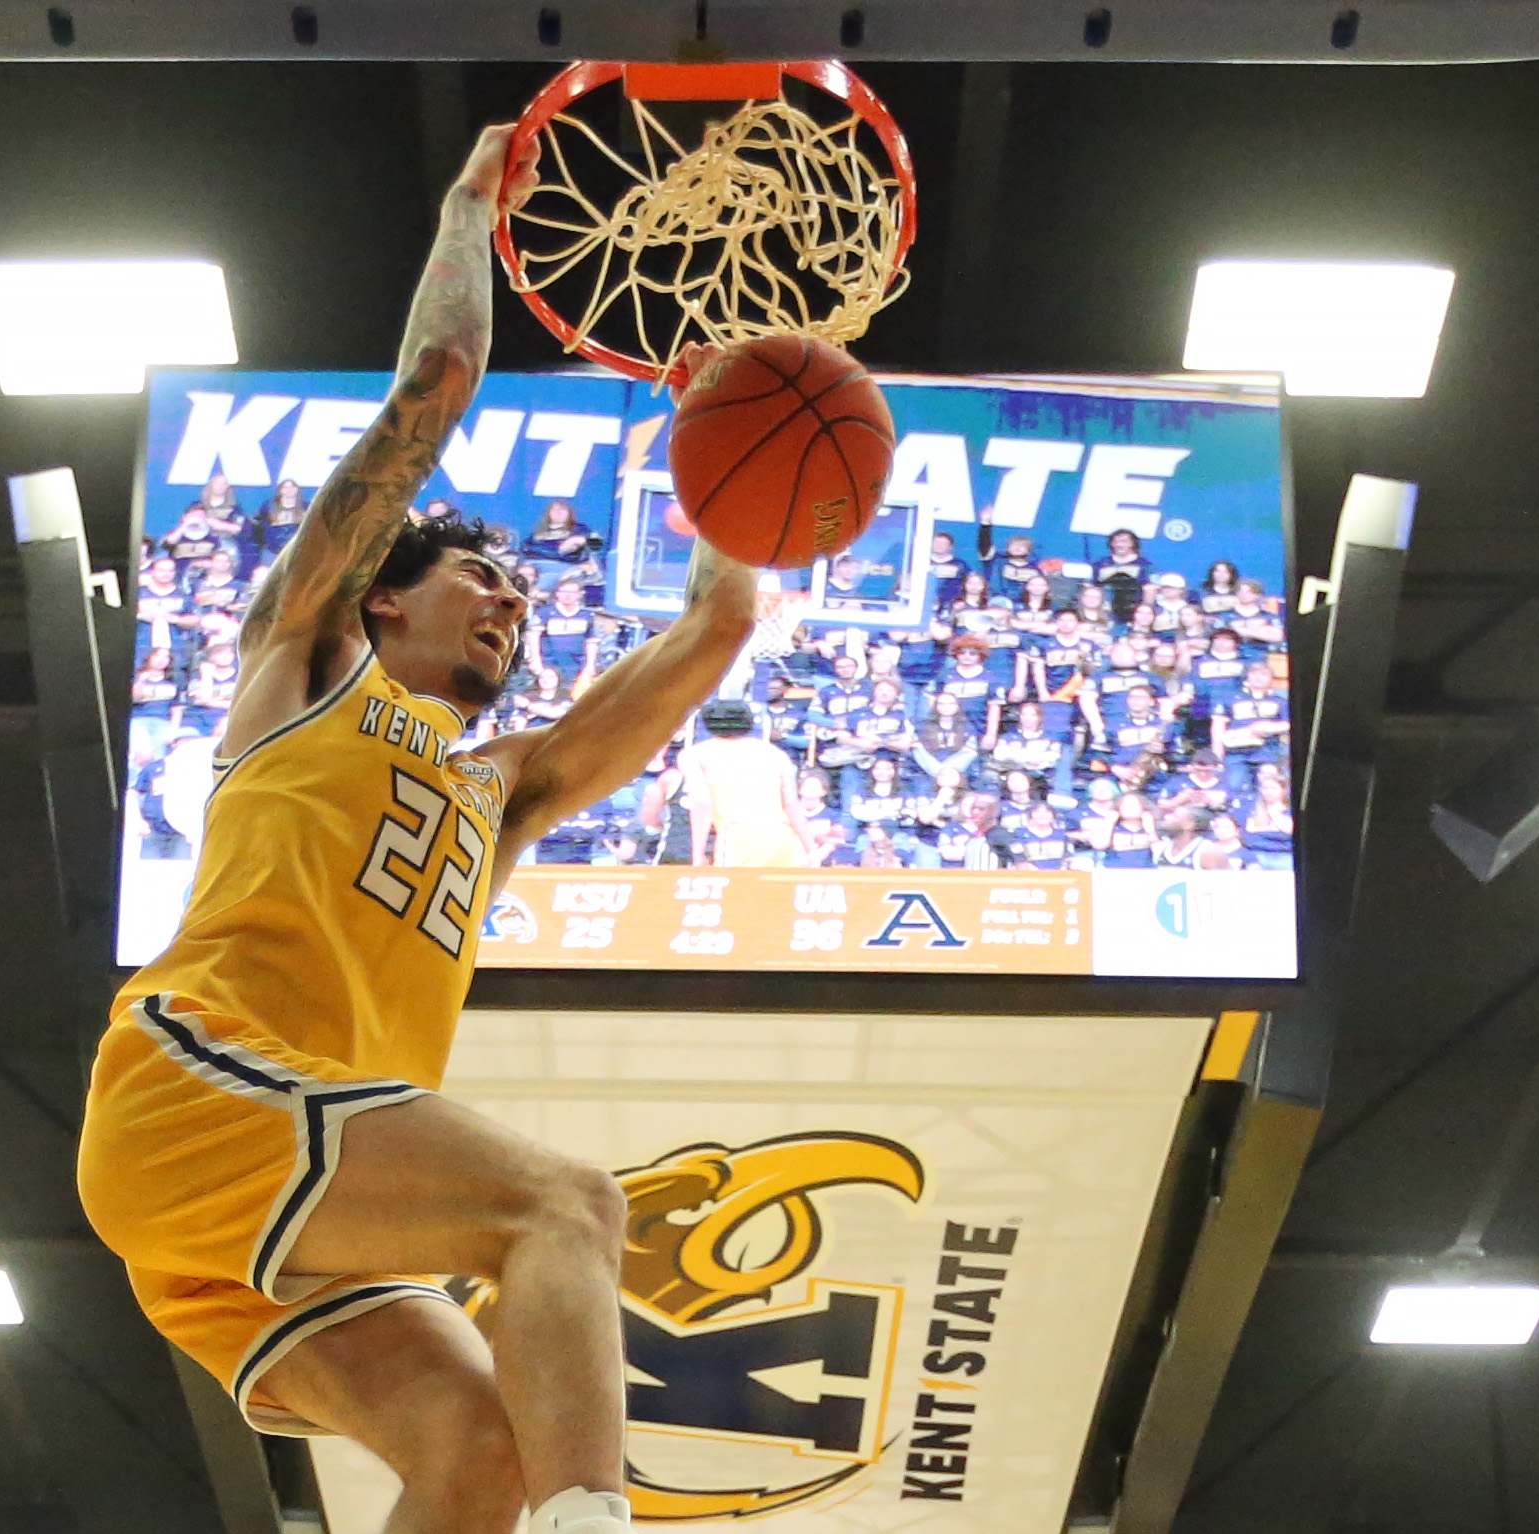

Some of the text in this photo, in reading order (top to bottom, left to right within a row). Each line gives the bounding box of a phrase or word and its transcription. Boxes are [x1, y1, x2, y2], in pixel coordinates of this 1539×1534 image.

[359, 696, 448, 767] KENT
[353, 763, 487, 961] 22
[552, 883, 633, 913] KSU
[674, 877, 730, 900] 1ST
[794, 885, 847, 913] UA
[561, 917, 616, 949] 25
[790, 919, 844, 950] 36
[864, 893, 969, 947] A
[901, 1219, 1019, 1501] KENT STATE
